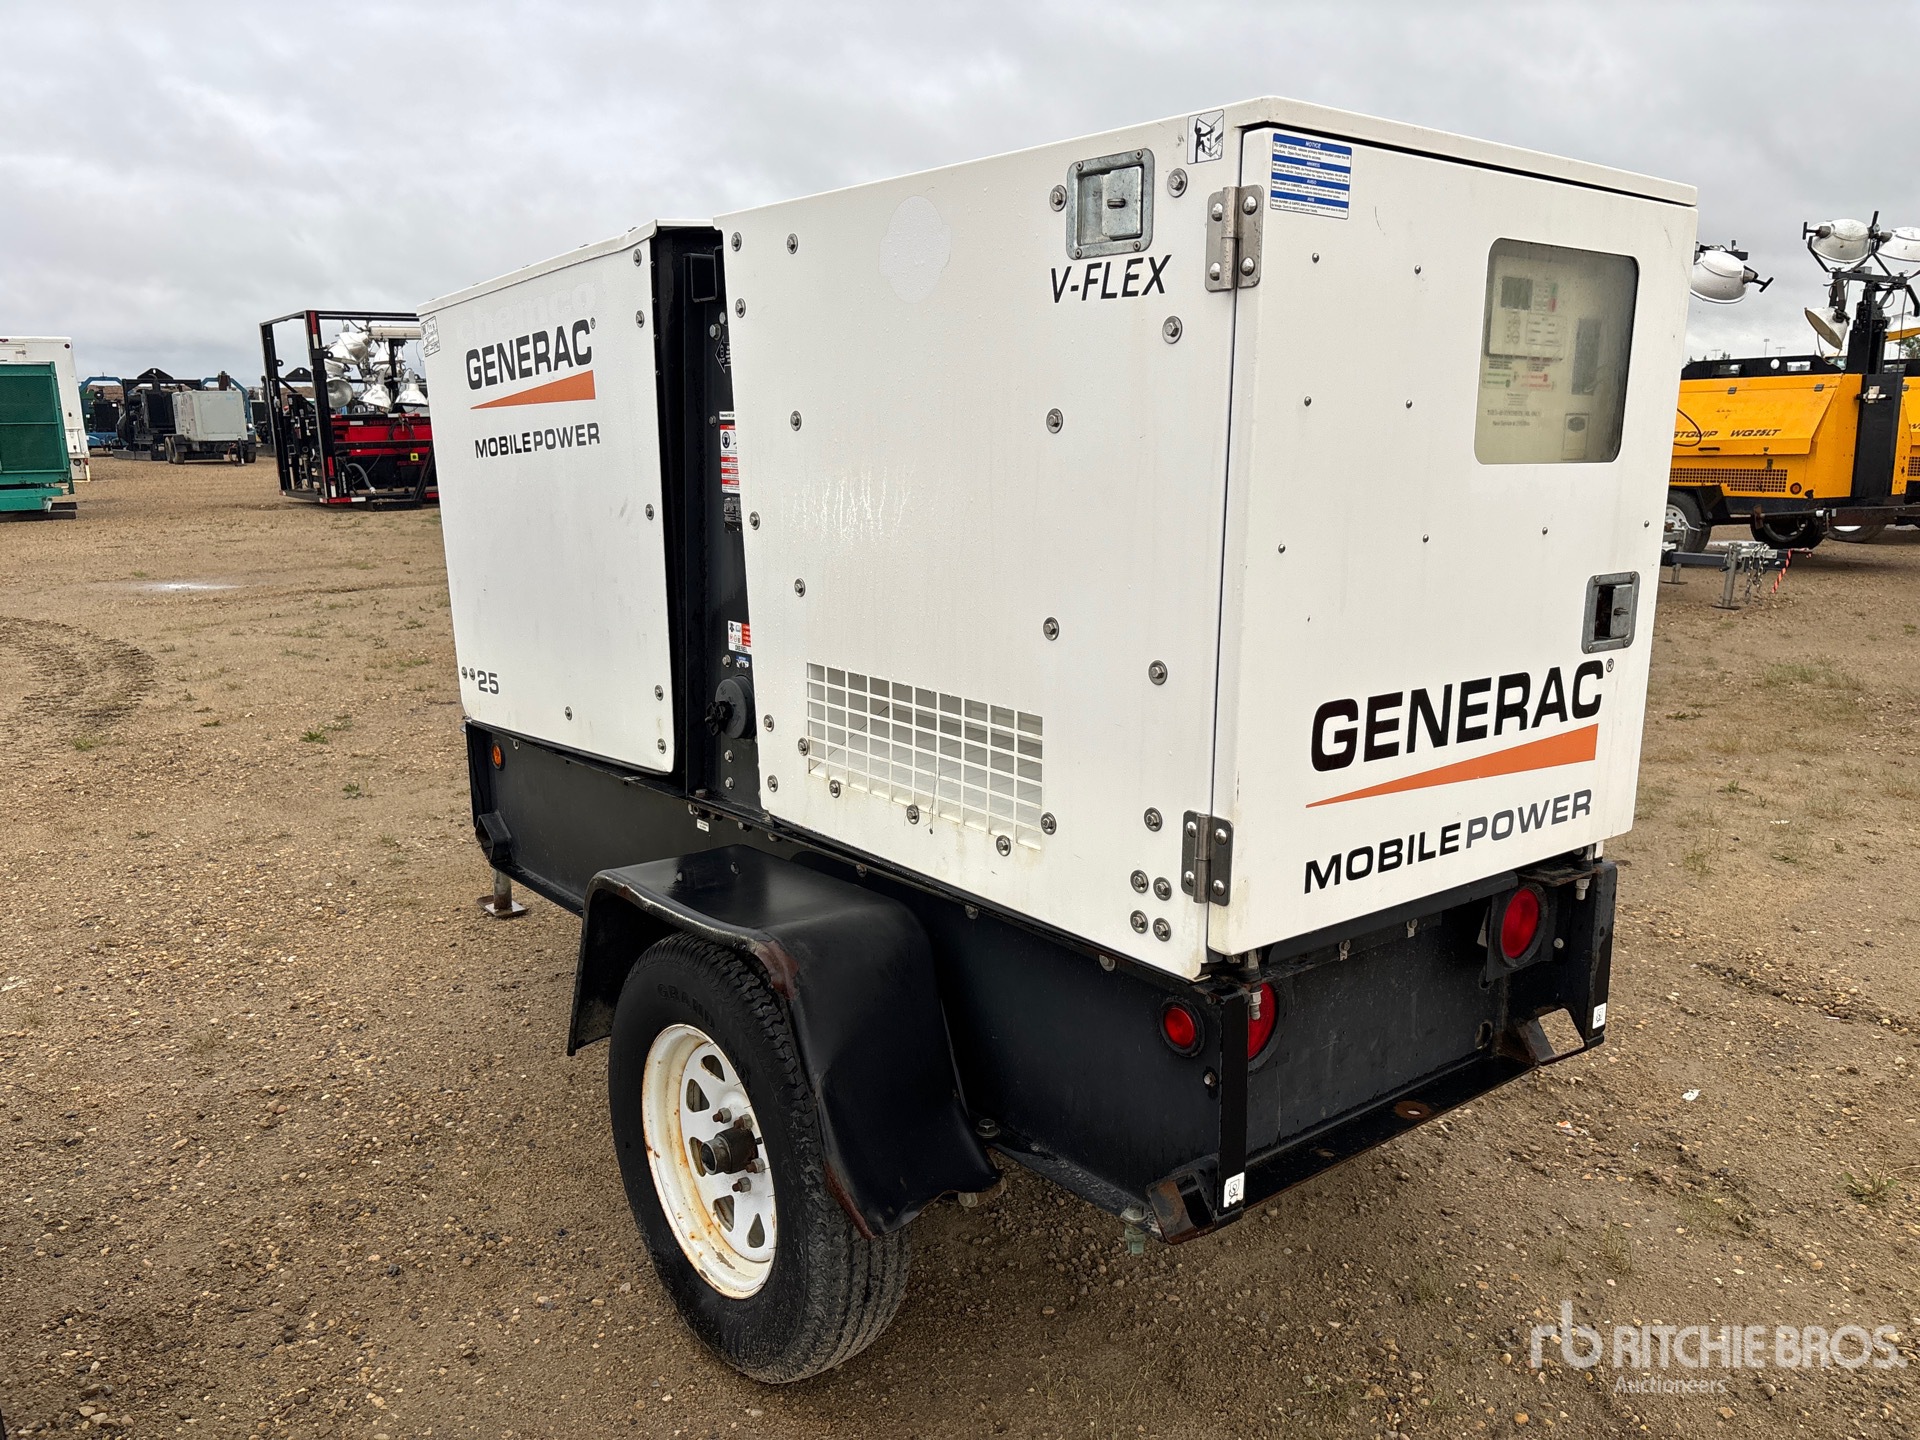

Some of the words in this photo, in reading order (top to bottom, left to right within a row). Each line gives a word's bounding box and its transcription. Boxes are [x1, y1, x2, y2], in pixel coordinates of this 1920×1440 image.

[1051, 254, 1172, 303] V-FLEX
[1730, 428, 1782, 437] WQ25LT
[477, 670, 499, 694] 25
